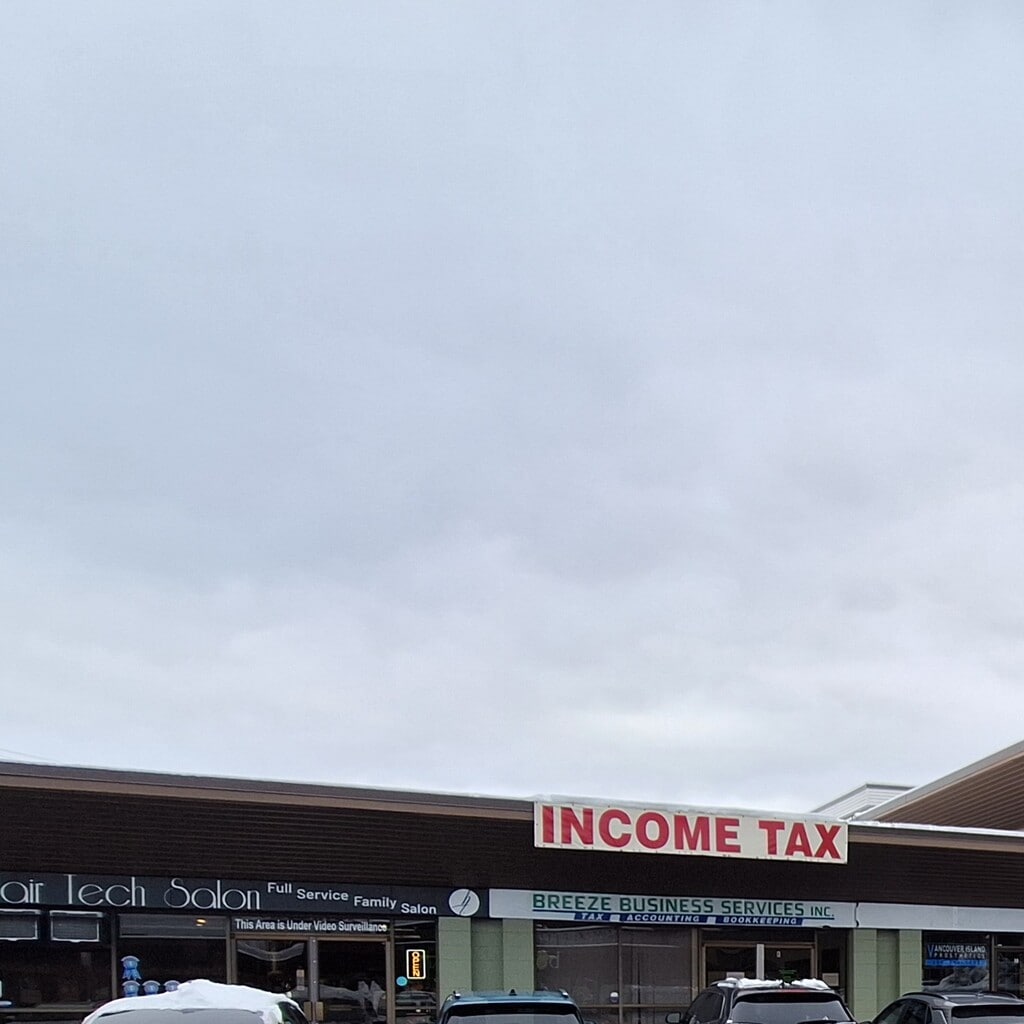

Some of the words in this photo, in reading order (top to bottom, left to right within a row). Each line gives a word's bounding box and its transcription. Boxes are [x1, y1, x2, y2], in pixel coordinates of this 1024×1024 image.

[541, 804, 742, 853] INCOME
[758, 820, 841, 860] TAX
[0, 879, 44, 904] air
[64, 874, 146, 906] Tech
[164, 877, 260, 910] Salon
[267, 882, 292, 894] Full
[297, 889, 349, 901] Service
[354, 896, 397, 909] Family
[401, 902, 437, 915] Salon
[532, 894, 612, 911] BREEZE
[619, 897, 714, 914] BUSINESS
[721, 901, 804, 917] SERVICES
[811, 906, 835, 917] INC.
[235, 918, 254, 930] This
[255, 919, 275, 930] Area
[277, 919, 285, 930] is
[286, 920, 311, 931] Under
[313, 920, 337, 931] Video
[338, 920, 388, 932] Surveillance
[581, 912, 604, 921] TAX
[626, 914, 700, 923] ACCOUNTING
[722, 917, 797, 926] BOOKKEEPING
